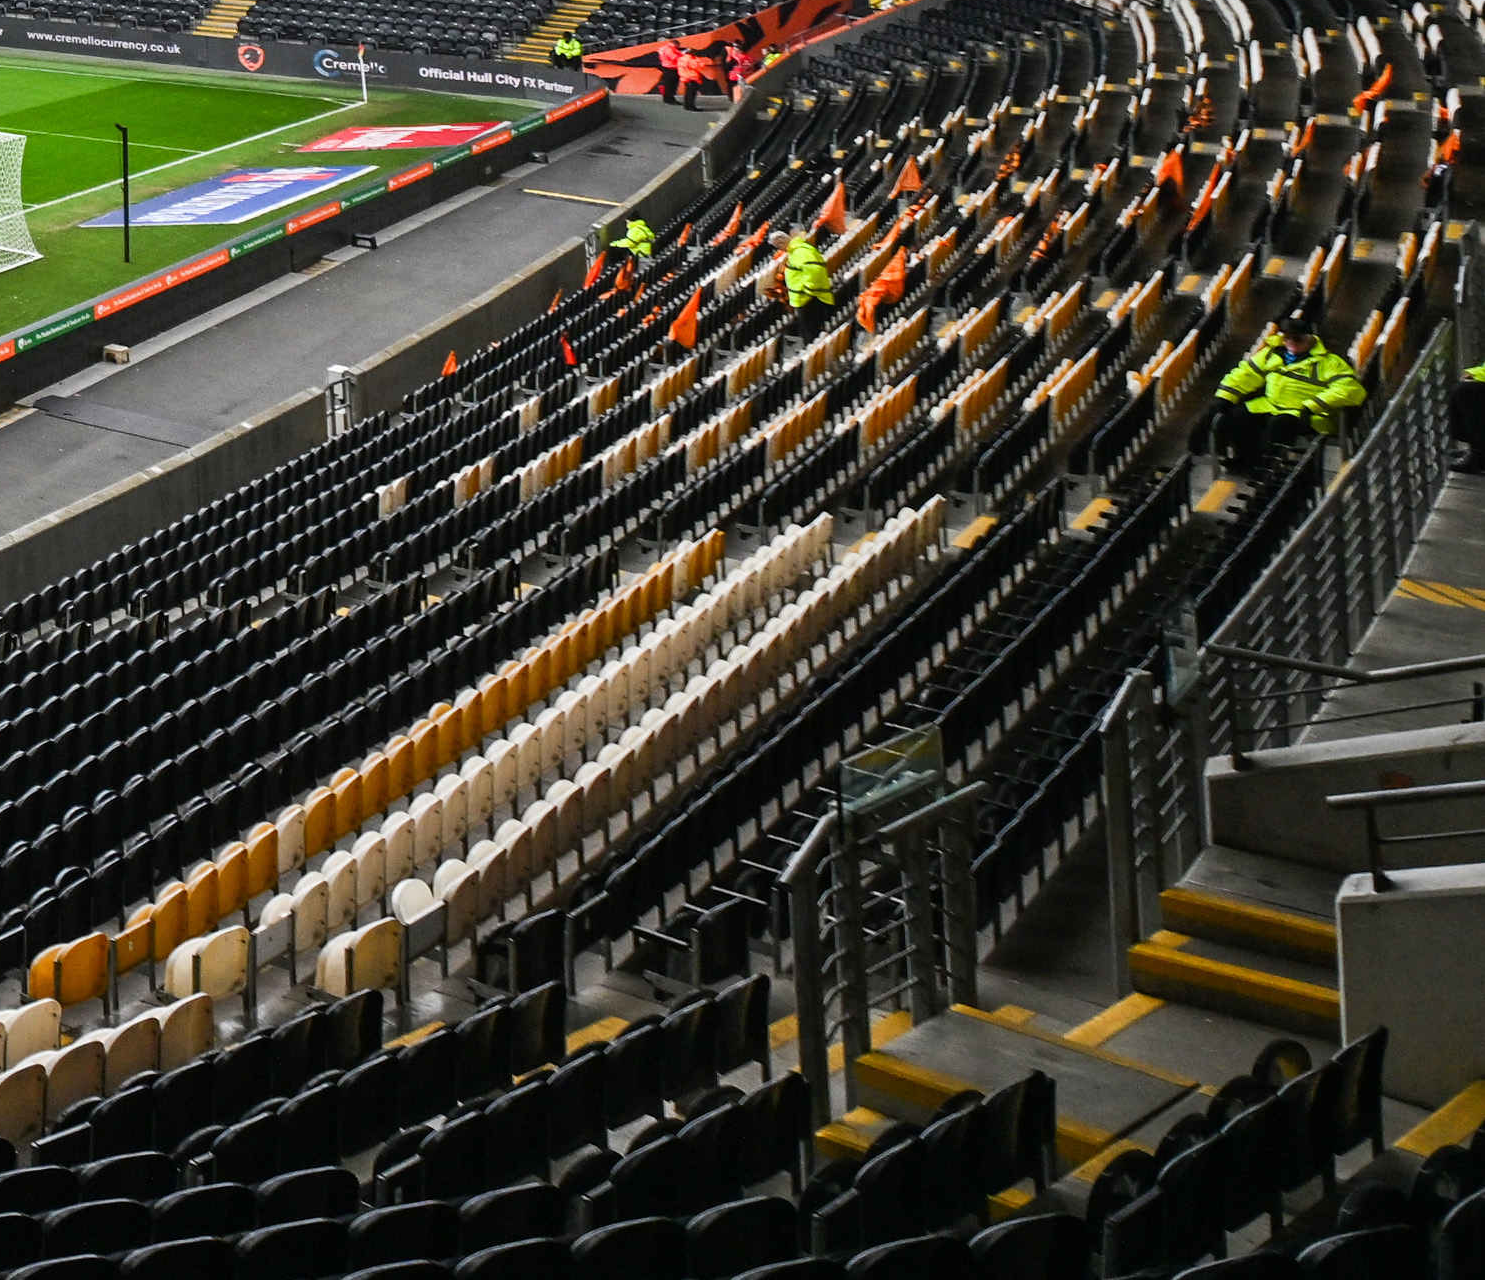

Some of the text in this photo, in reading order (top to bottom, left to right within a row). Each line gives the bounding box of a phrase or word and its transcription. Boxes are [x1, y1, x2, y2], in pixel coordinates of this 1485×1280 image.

[27, 30, 181, 55] www.cremellocurrency.co.uk
[419, 67, 574, 94] Official Hull City FX Partner
